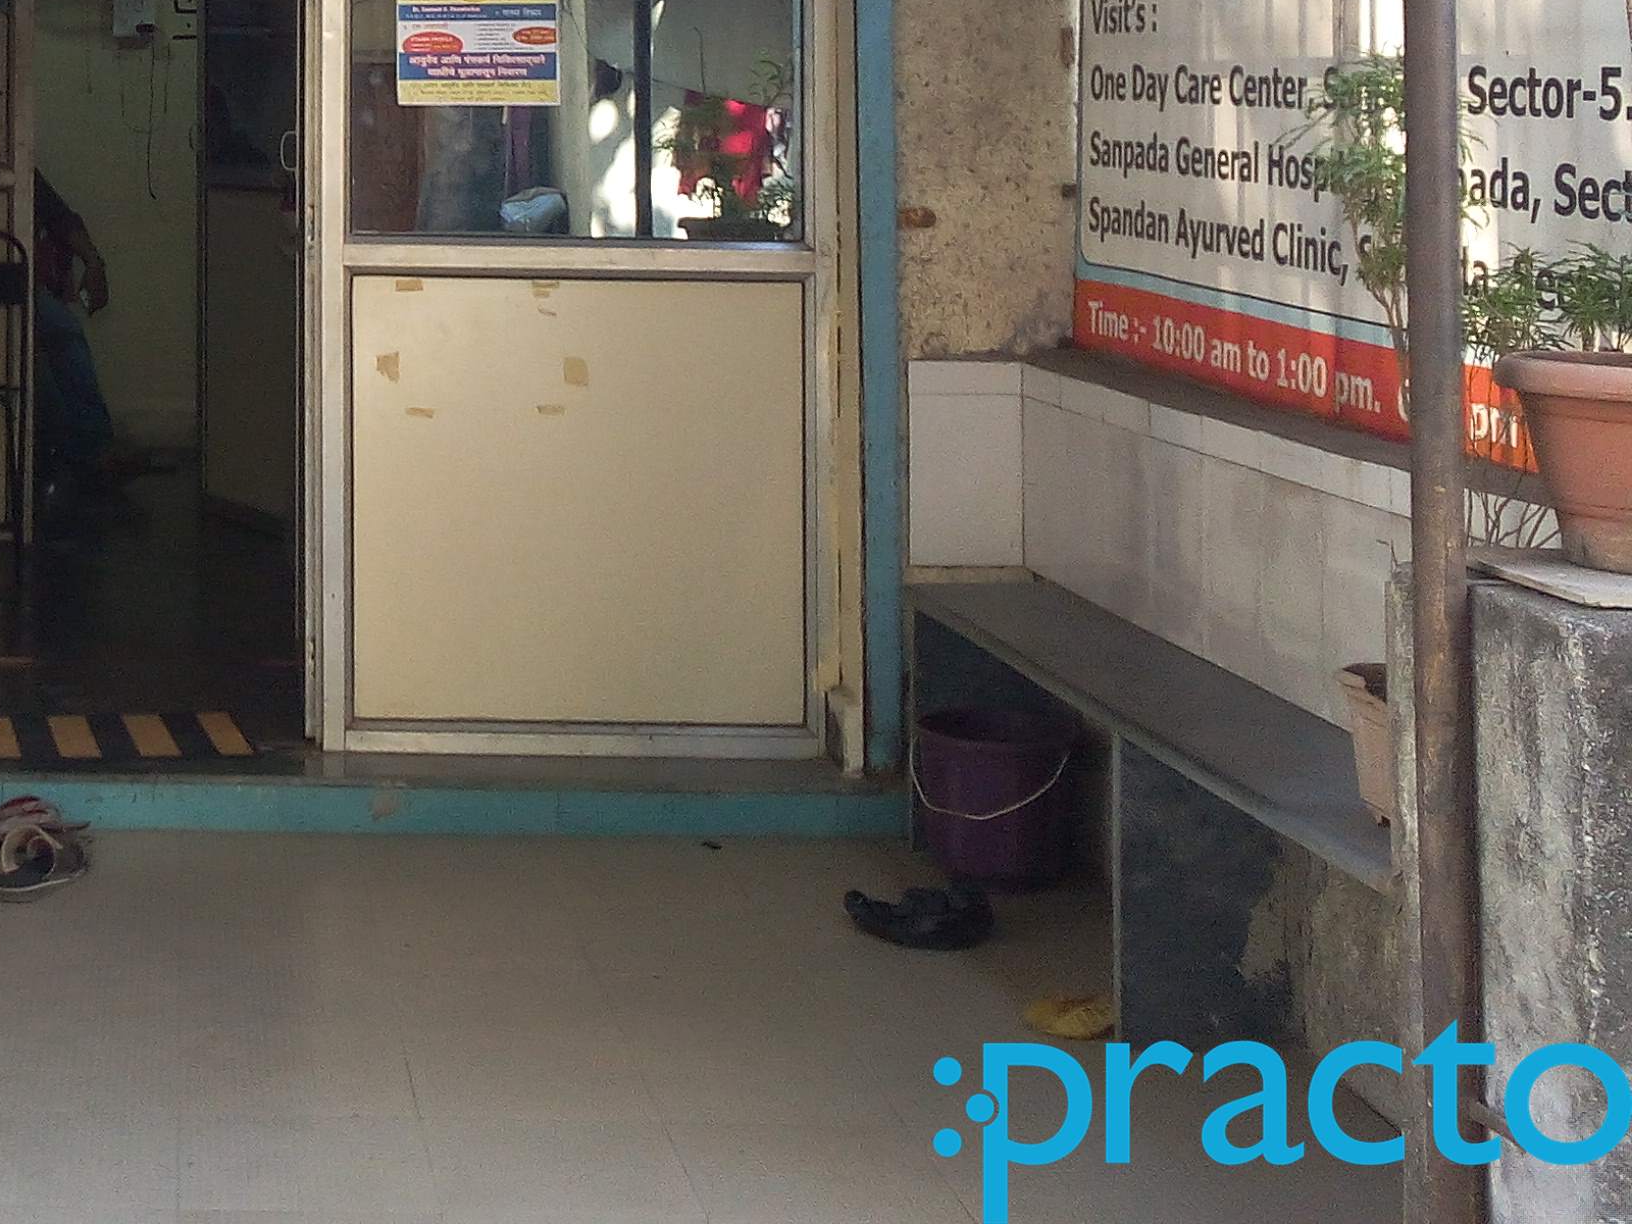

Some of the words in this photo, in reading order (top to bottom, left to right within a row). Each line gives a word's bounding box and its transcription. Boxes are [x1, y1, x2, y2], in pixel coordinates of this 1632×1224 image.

[1090, 63, 1126, 101] One
[1132, 63, 1167, 113] Day
[1174, 64, 1222, 106] Care
[1090, 130, 1169, 179] Sanpada
[1175, 136, 1260, 184] General
[1088, 195, 1169, 244] Spandan
[1175, 207, 1265, 260] Ayurved
[1272, 222, 1349, 287] Clinic,
[1089, 299, 1129, 342] Time
[1152, 314, 1206, 364] 10:00
[1210, 339, 1242, 374] am
[1247, 339, 1270, 381] to
[1276, 347, 1328, 398] 1:00
